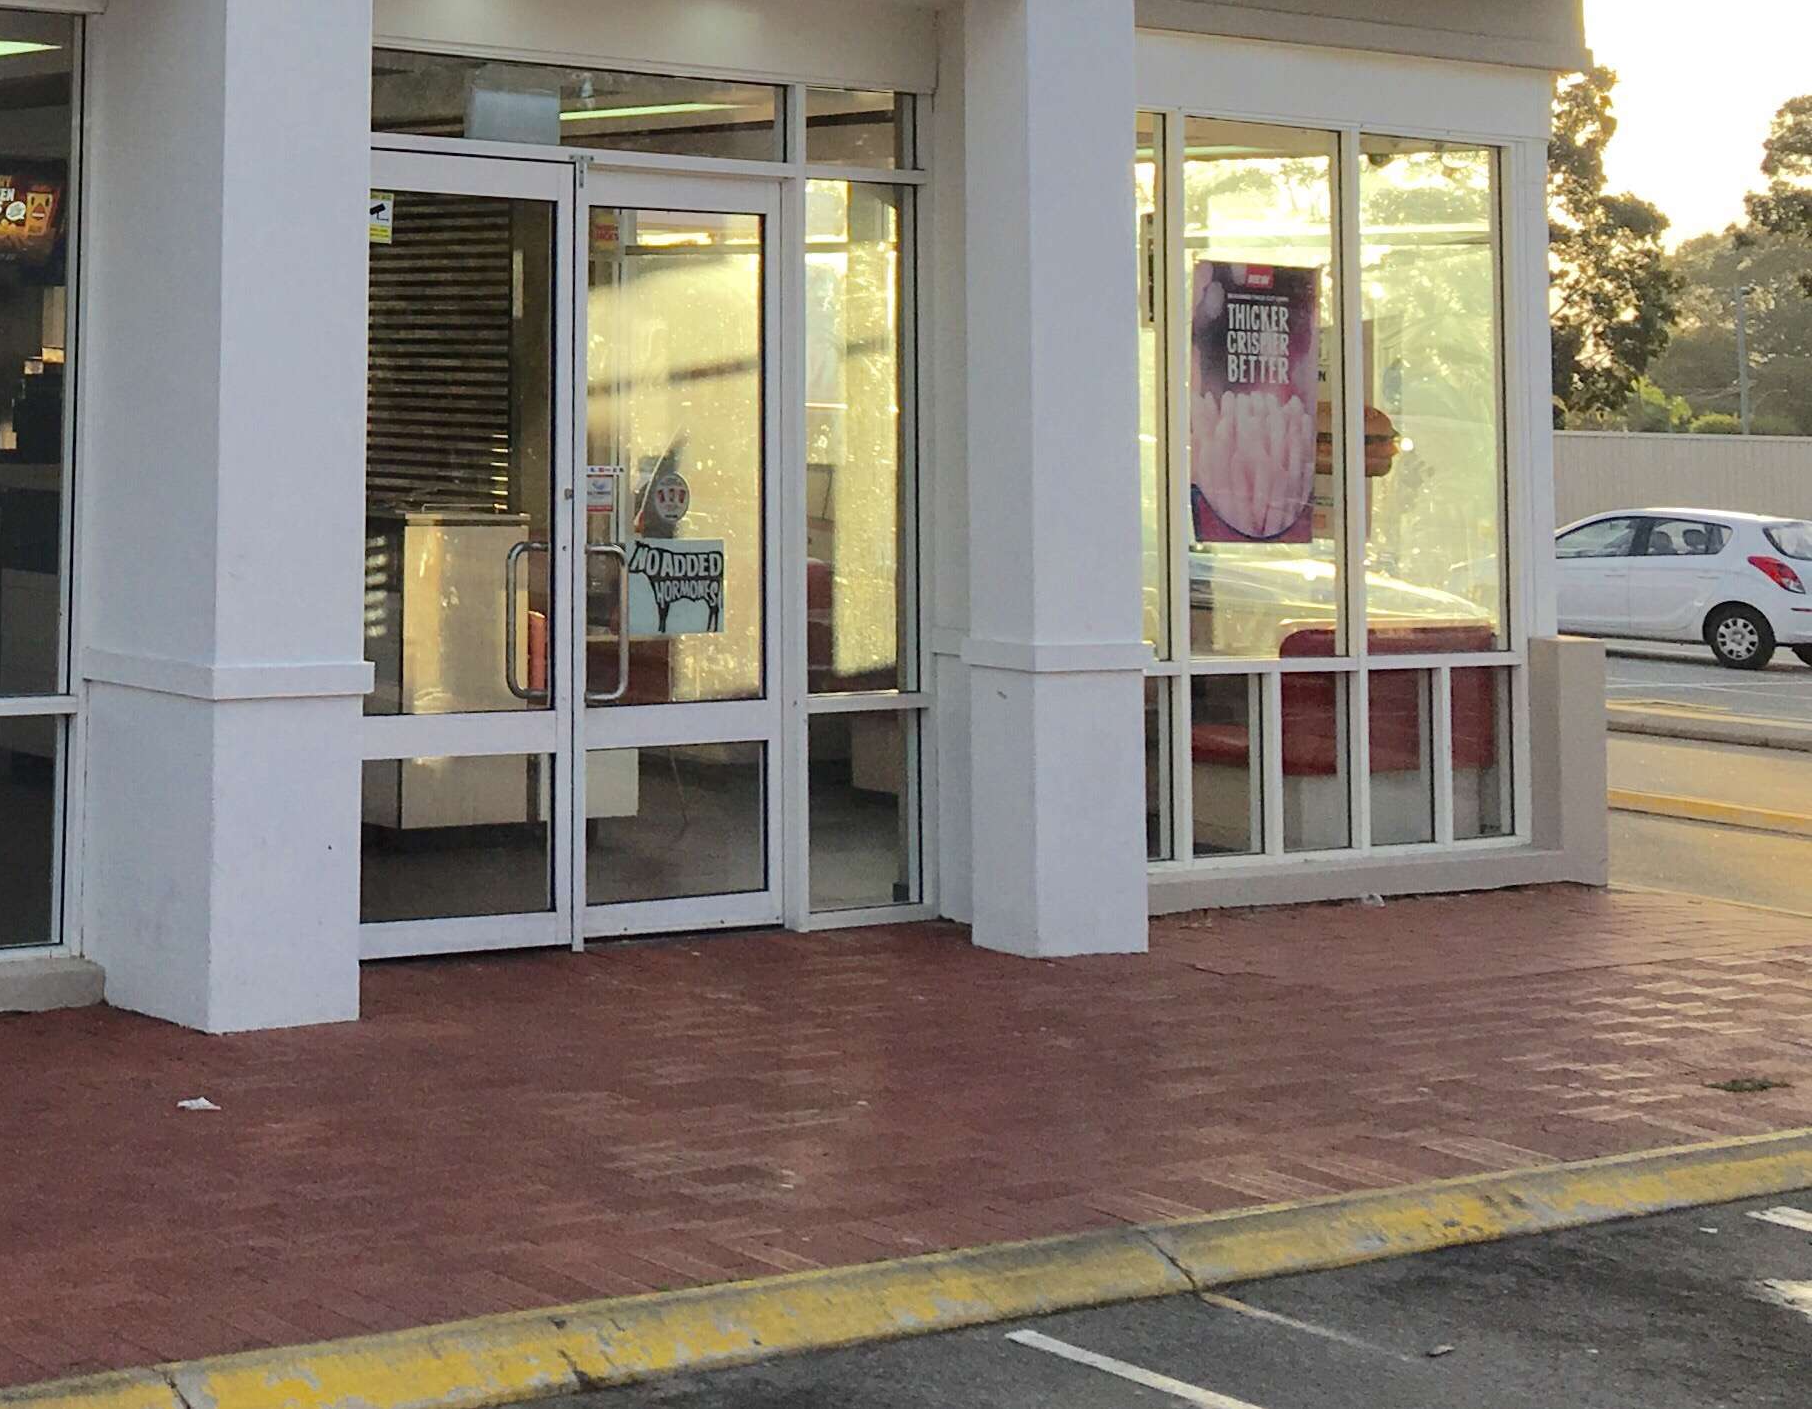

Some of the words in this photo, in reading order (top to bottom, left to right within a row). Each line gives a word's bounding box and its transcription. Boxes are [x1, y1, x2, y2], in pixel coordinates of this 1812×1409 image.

[1227, 303, 1289, 332] THICKER
[1228, 354, 1290, 384] BETTER
[629, 546, 661, 576] NO
[660, 552, 723, 577] ADDED
[654, 579, 720, 609] HORMONES
